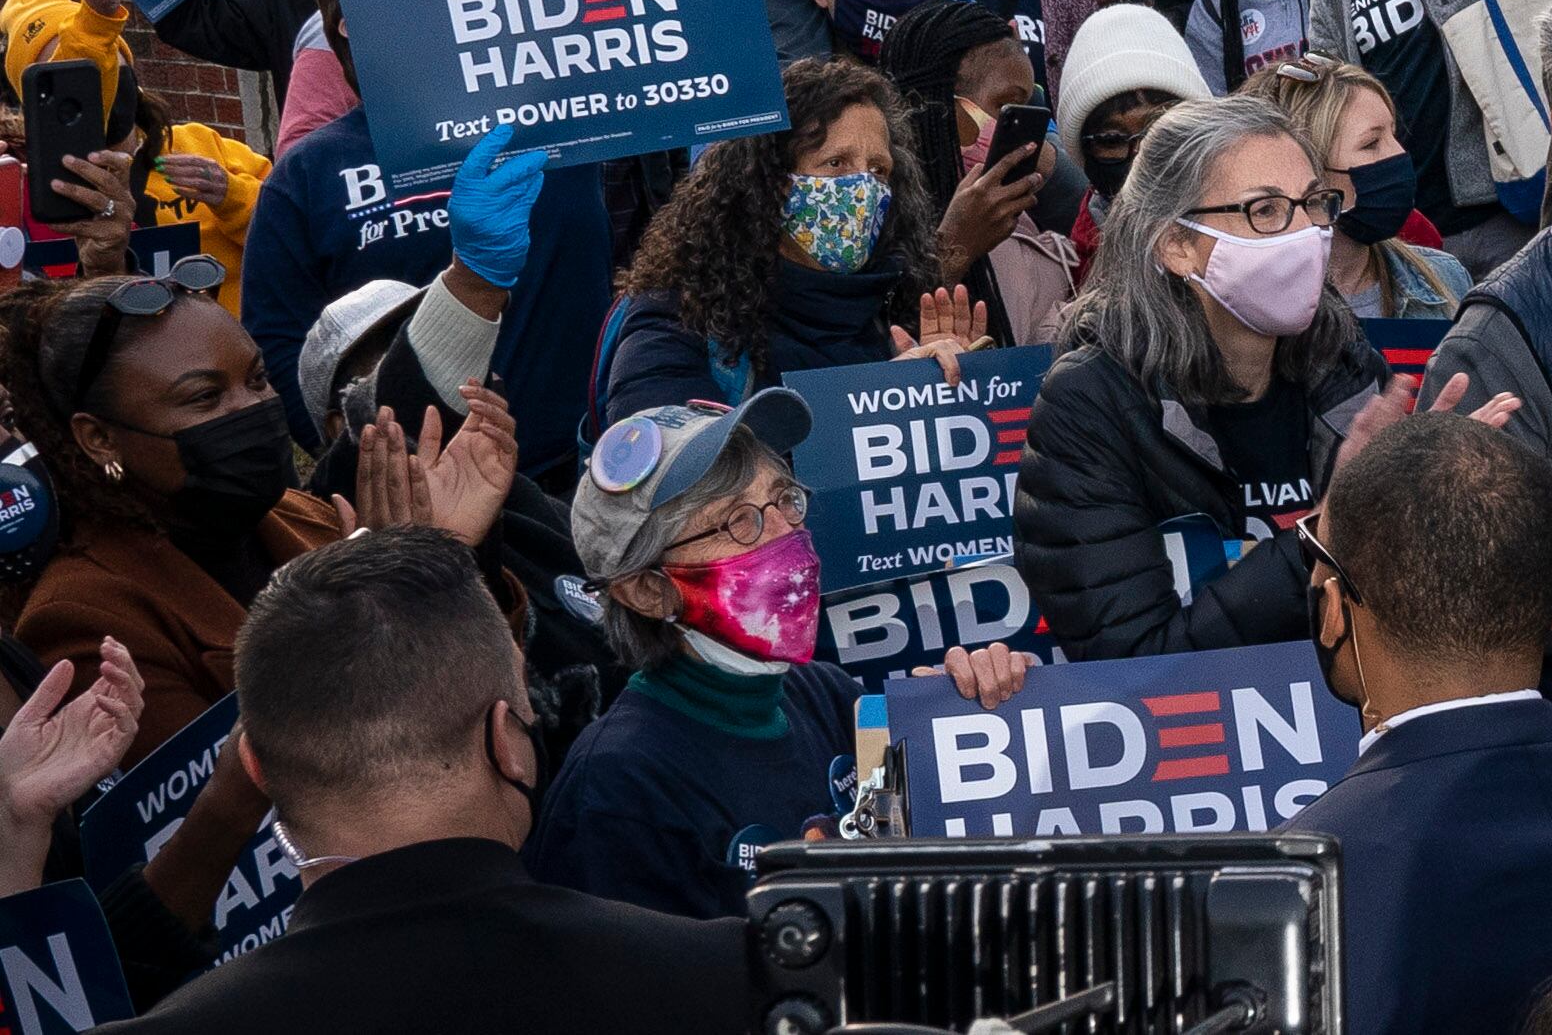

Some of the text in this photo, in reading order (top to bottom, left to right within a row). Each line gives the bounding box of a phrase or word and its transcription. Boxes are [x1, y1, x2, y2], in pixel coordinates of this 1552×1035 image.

[459, 19, 689, 93] HARRIS
[436, 74, 729, 142] Text POWER to 30330
[848, 375, 1022, 415] WOMEN for
[852, 407, 1032, 481] BIDE
[857, 552, 903, 572] Text
[826, 564, 1040, 664] BID
[931, 680, 1324, 804] BIDEN
